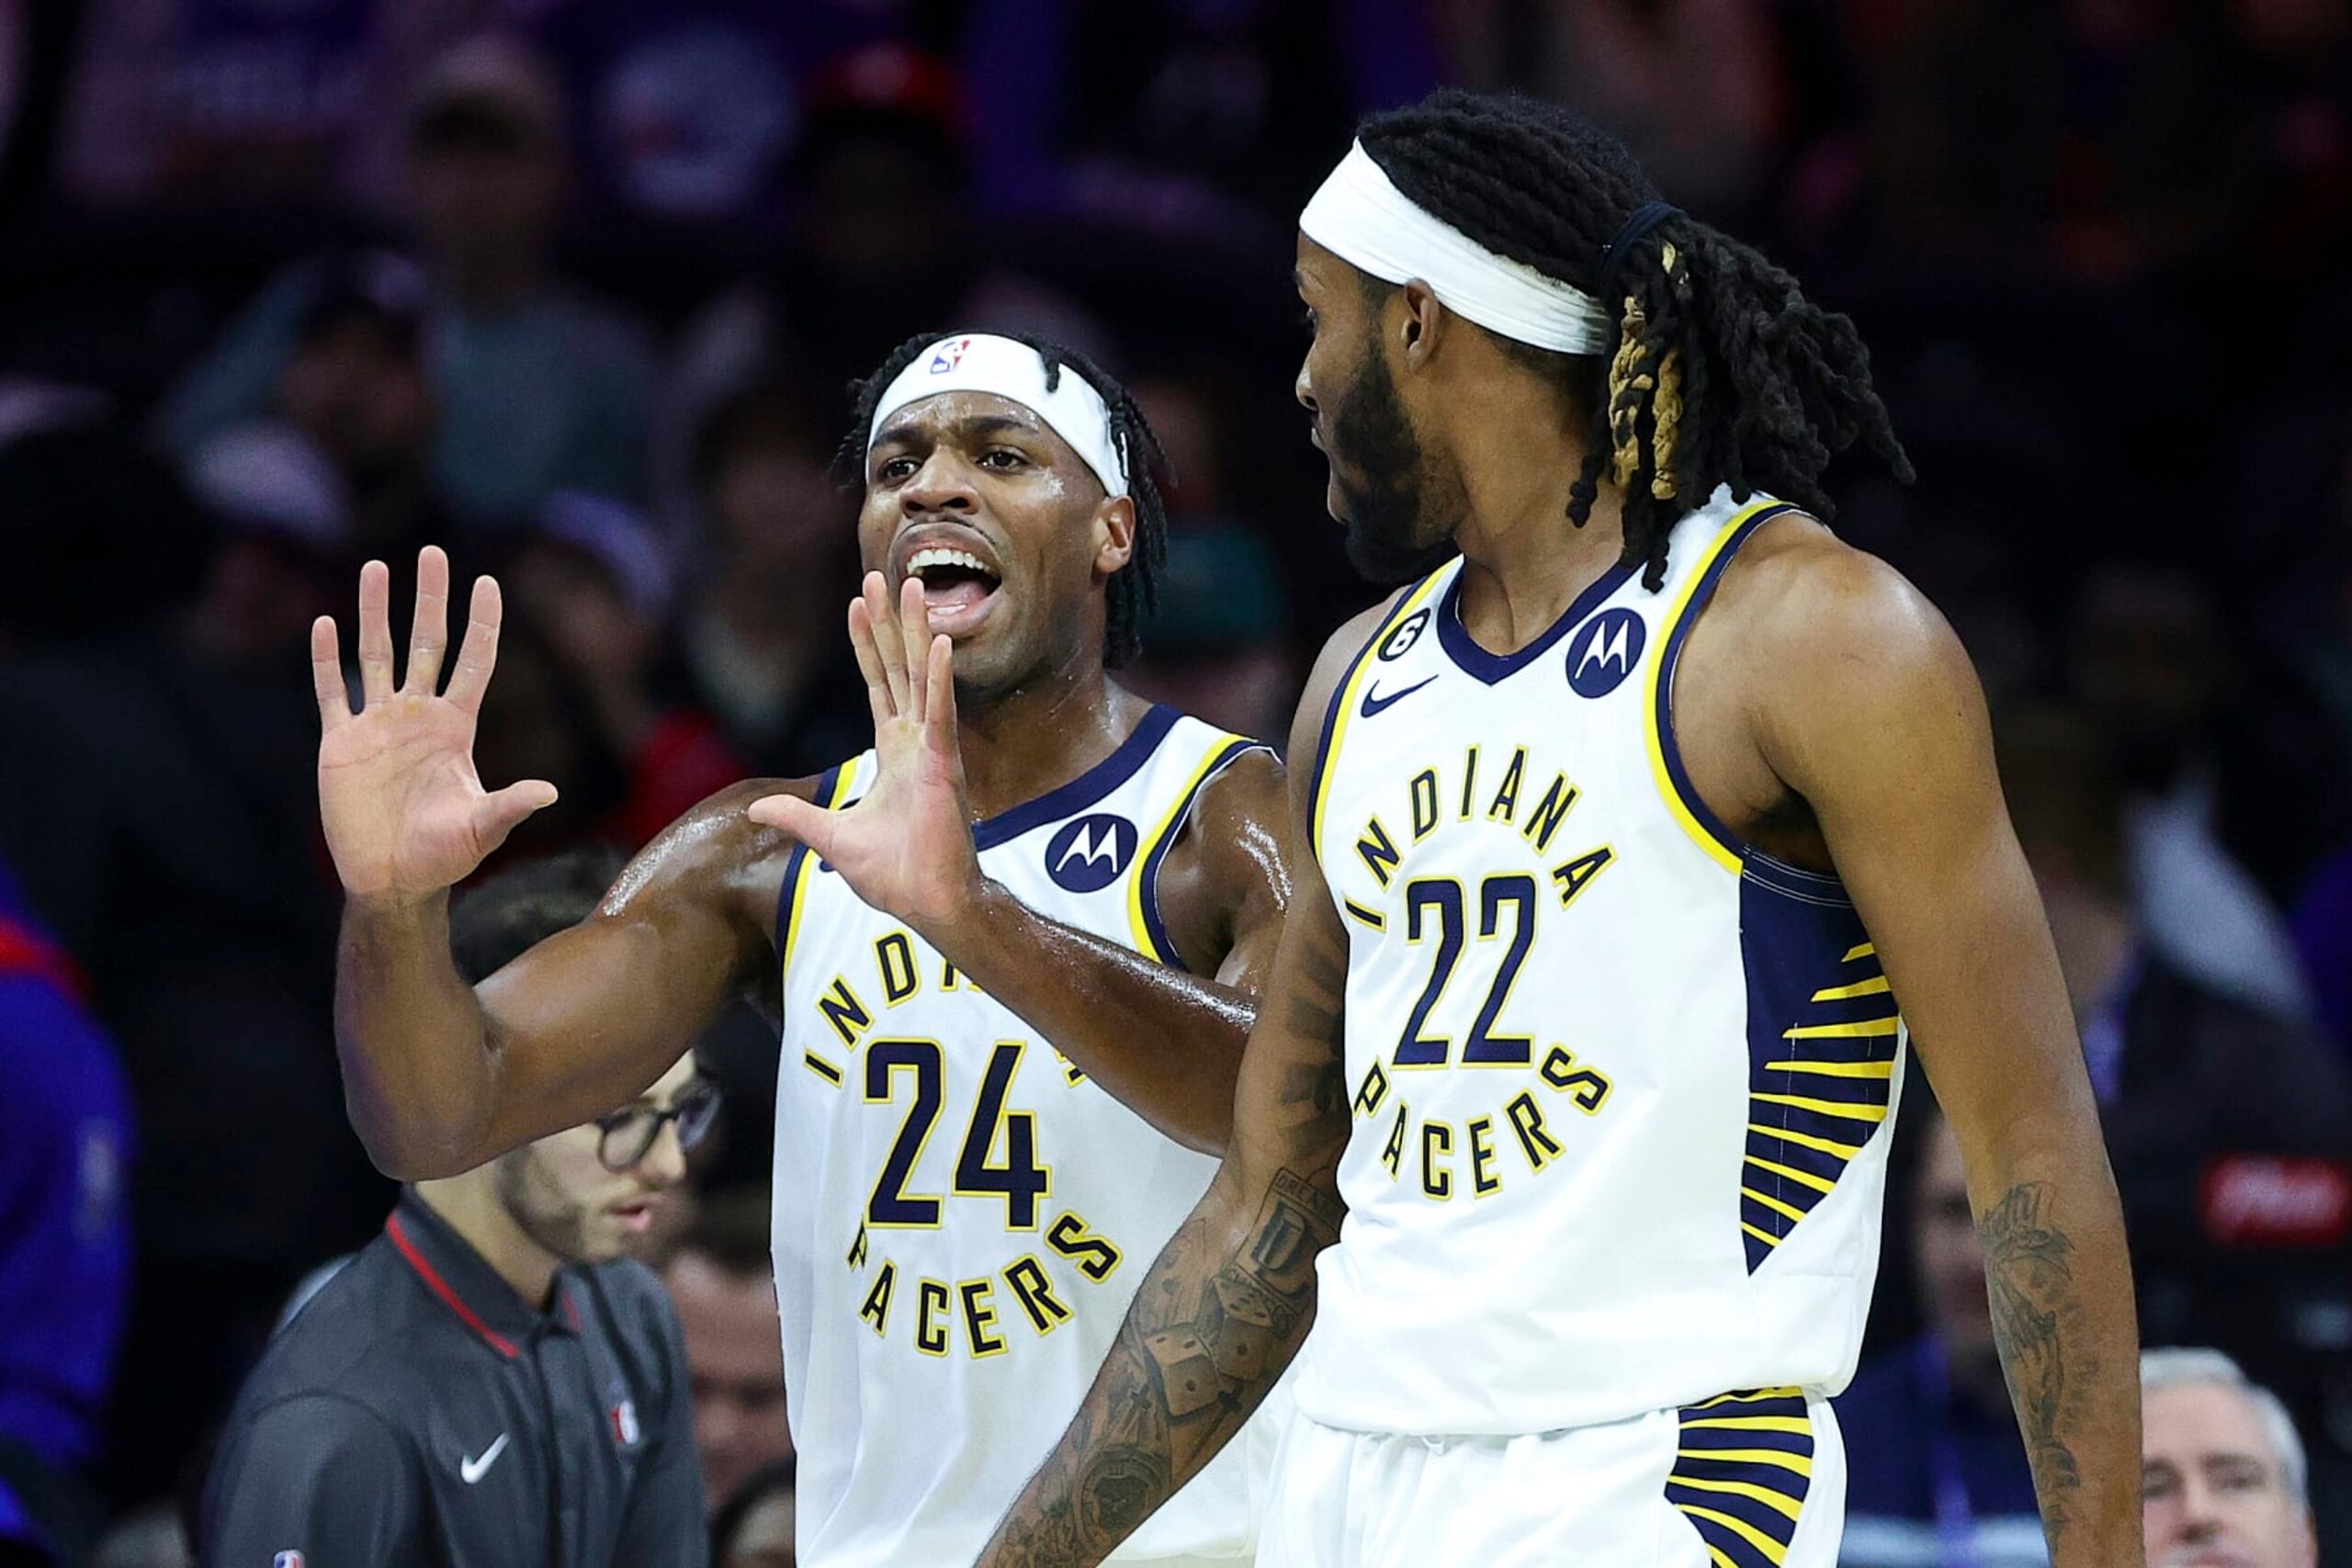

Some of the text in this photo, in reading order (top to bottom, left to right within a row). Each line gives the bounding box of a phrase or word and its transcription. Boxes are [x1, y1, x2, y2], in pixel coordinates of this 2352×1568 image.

[1342, 743, 1618, 933] INDIANA
[1389, 871, 1538, 1070] 22
[862, 1035, 1053, 1233] 24
[1353, 1043, 1614, 1201] PACERS
